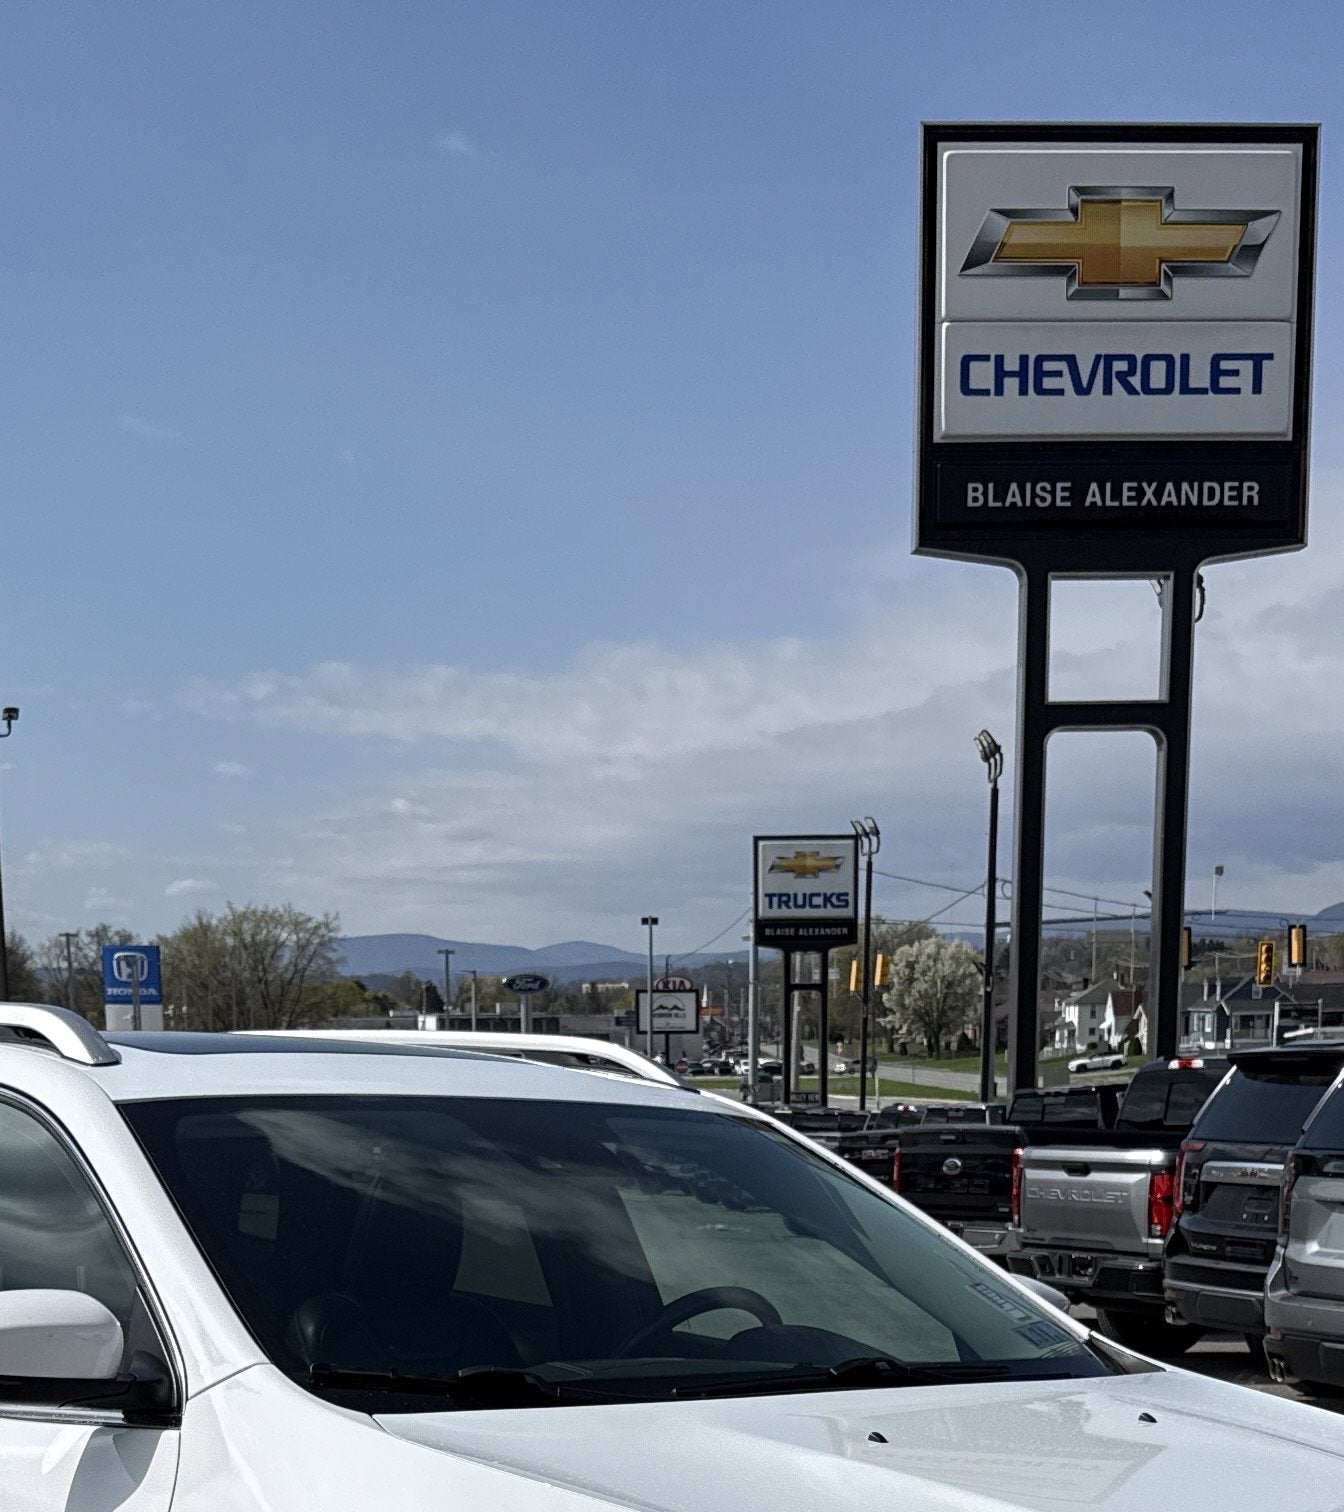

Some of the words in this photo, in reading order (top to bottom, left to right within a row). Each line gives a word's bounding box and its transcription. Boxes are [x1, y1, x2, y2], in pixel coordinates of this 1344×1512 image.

[960, 353, 1274, 397] CHEVROLET
[966, 482, 1072, 508] BLAISE
[1084, 481, 1260, 508] ALEXANDER
[764, 892, 850, 910] TRUCKS
[764, 927, 795, 936] BLAISE
[798, 927, 848, 936] ALEXANDER
[1026, 1187, 1129, 1204] CHEVROLET
